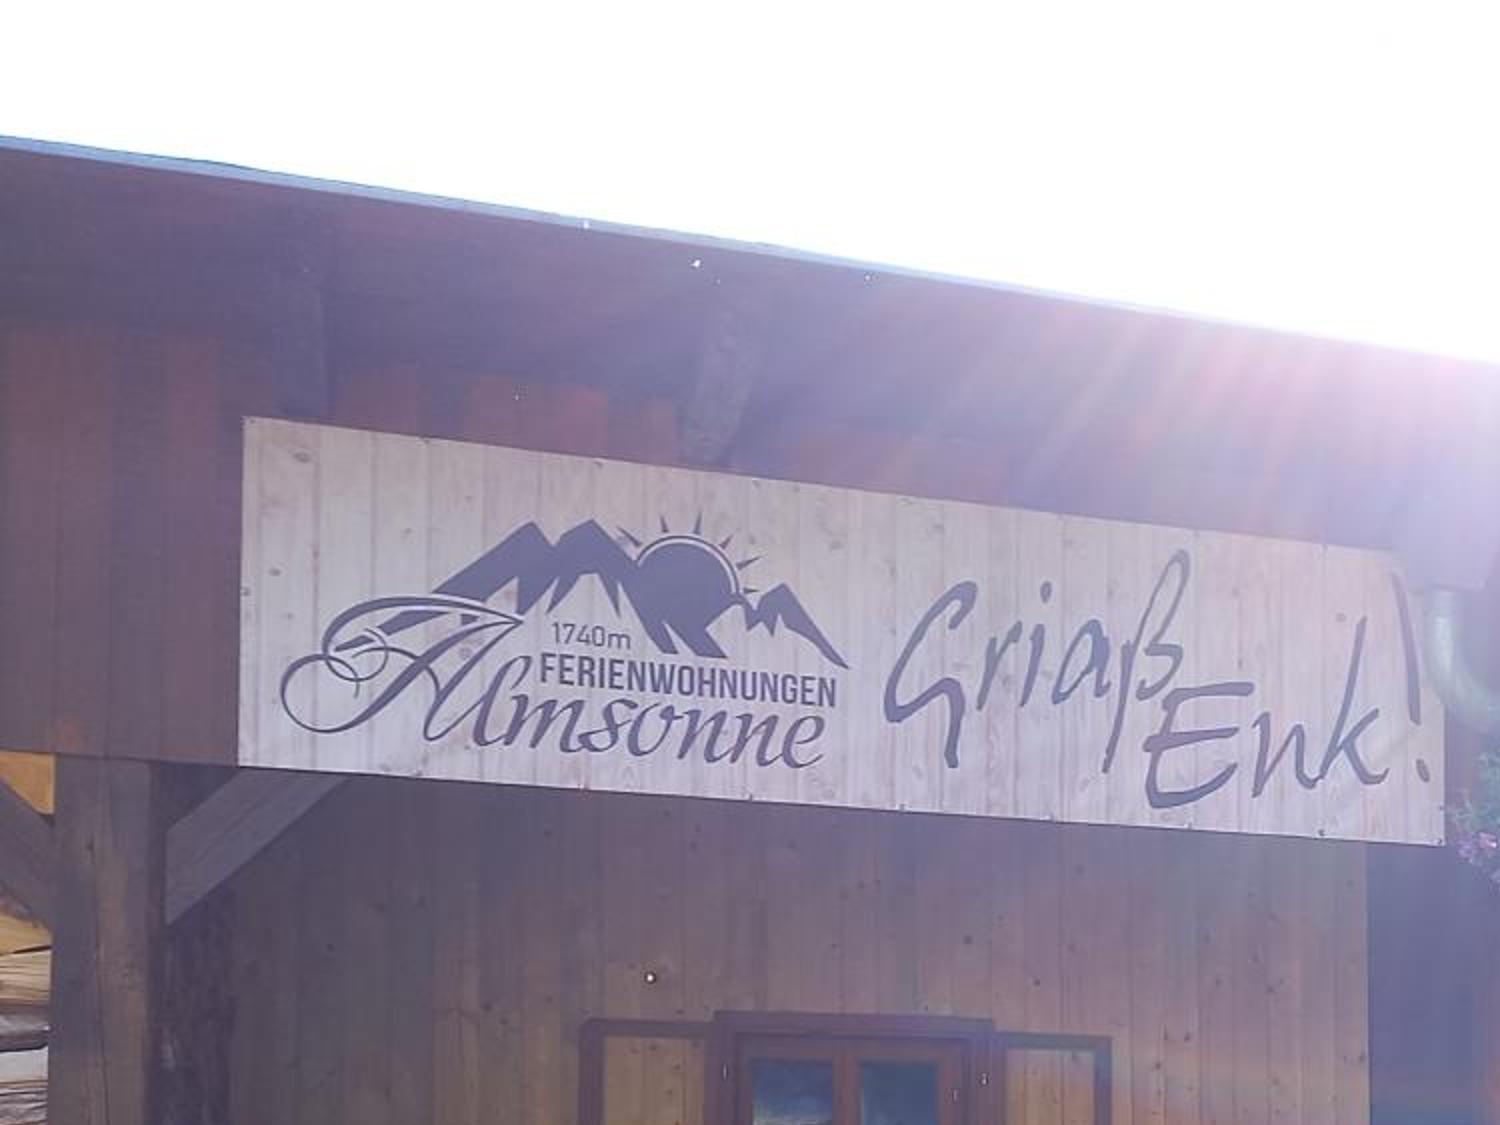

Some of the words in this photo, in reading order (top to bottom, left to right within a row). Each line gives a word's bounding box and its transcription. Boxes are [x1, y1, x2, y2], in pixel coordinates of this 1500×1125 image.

[280, 595, 827, 769] Almsonne
[539, 651, 837, 708] FERIENWOHNUNGEN
[550, 621, 632, 649] 1740m
[884, 549, 1191, 774] Griaß
[1142, 572, 1431, 809] Enk!
